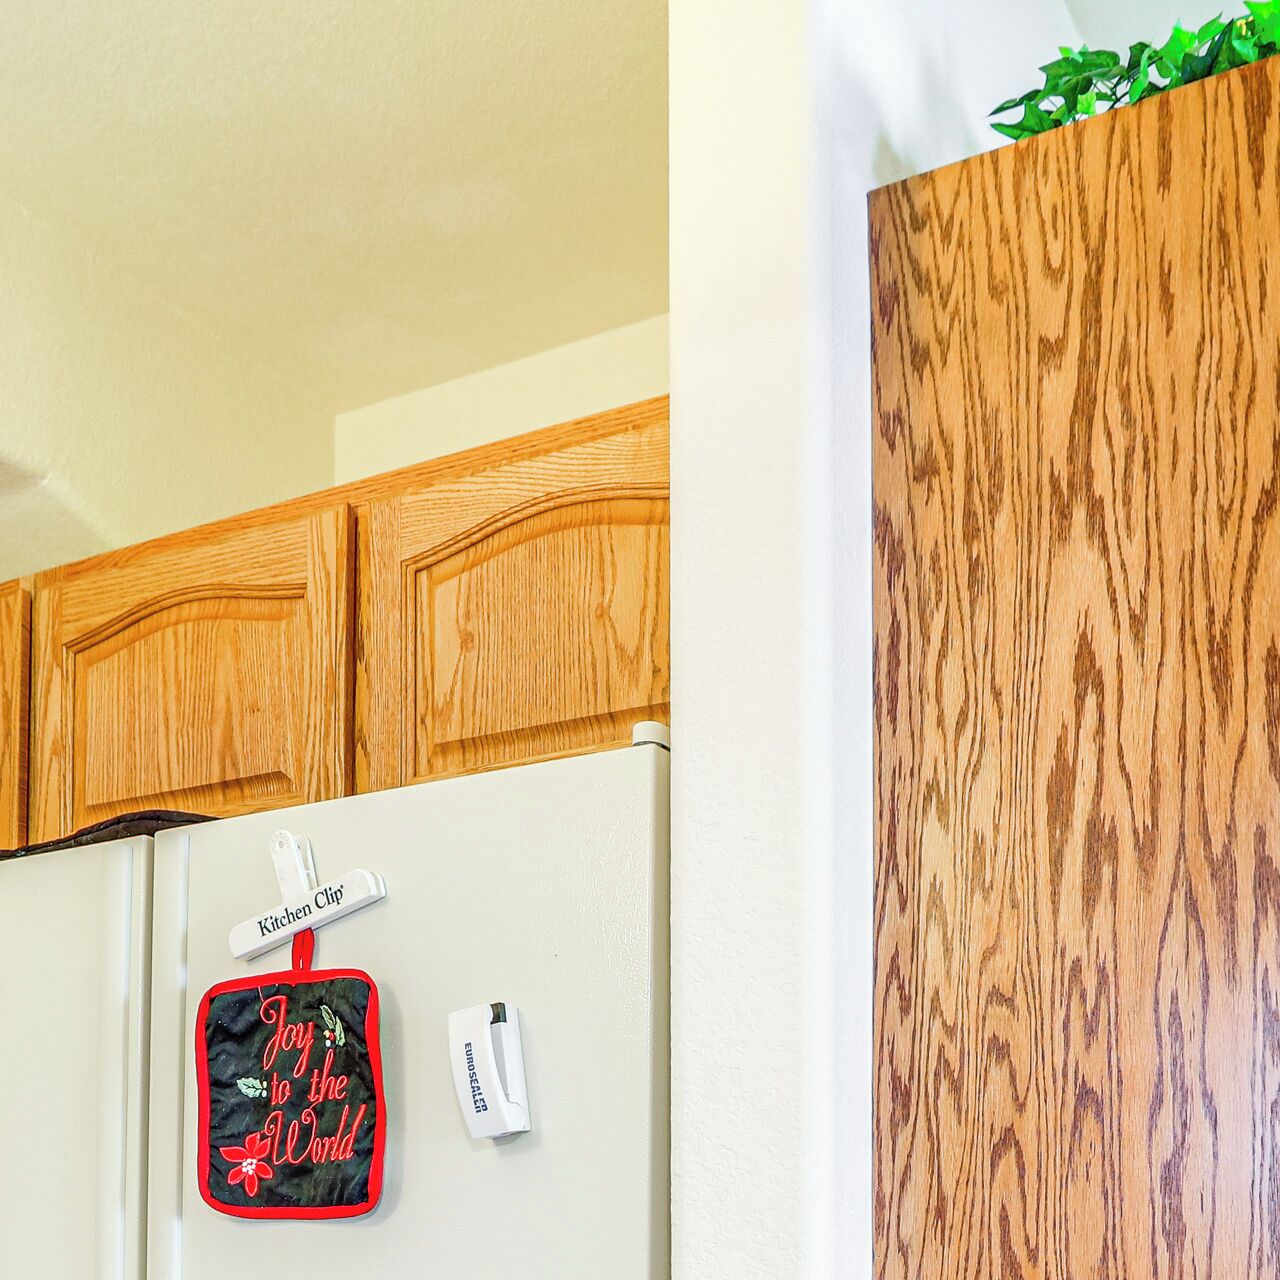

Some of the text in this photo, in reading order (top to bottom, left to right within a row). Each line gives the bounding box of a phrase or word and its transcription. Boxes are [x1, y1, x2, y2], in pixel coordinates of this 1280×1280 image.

[257, 907, 312, 937] Kitchen
[260, 995, 315, 1078] Joy
[271, 1048, 349, 1106] to the
[464, 1042, 488, 1114] EUROSEALER
[265, 1103, 367, 1166] World
